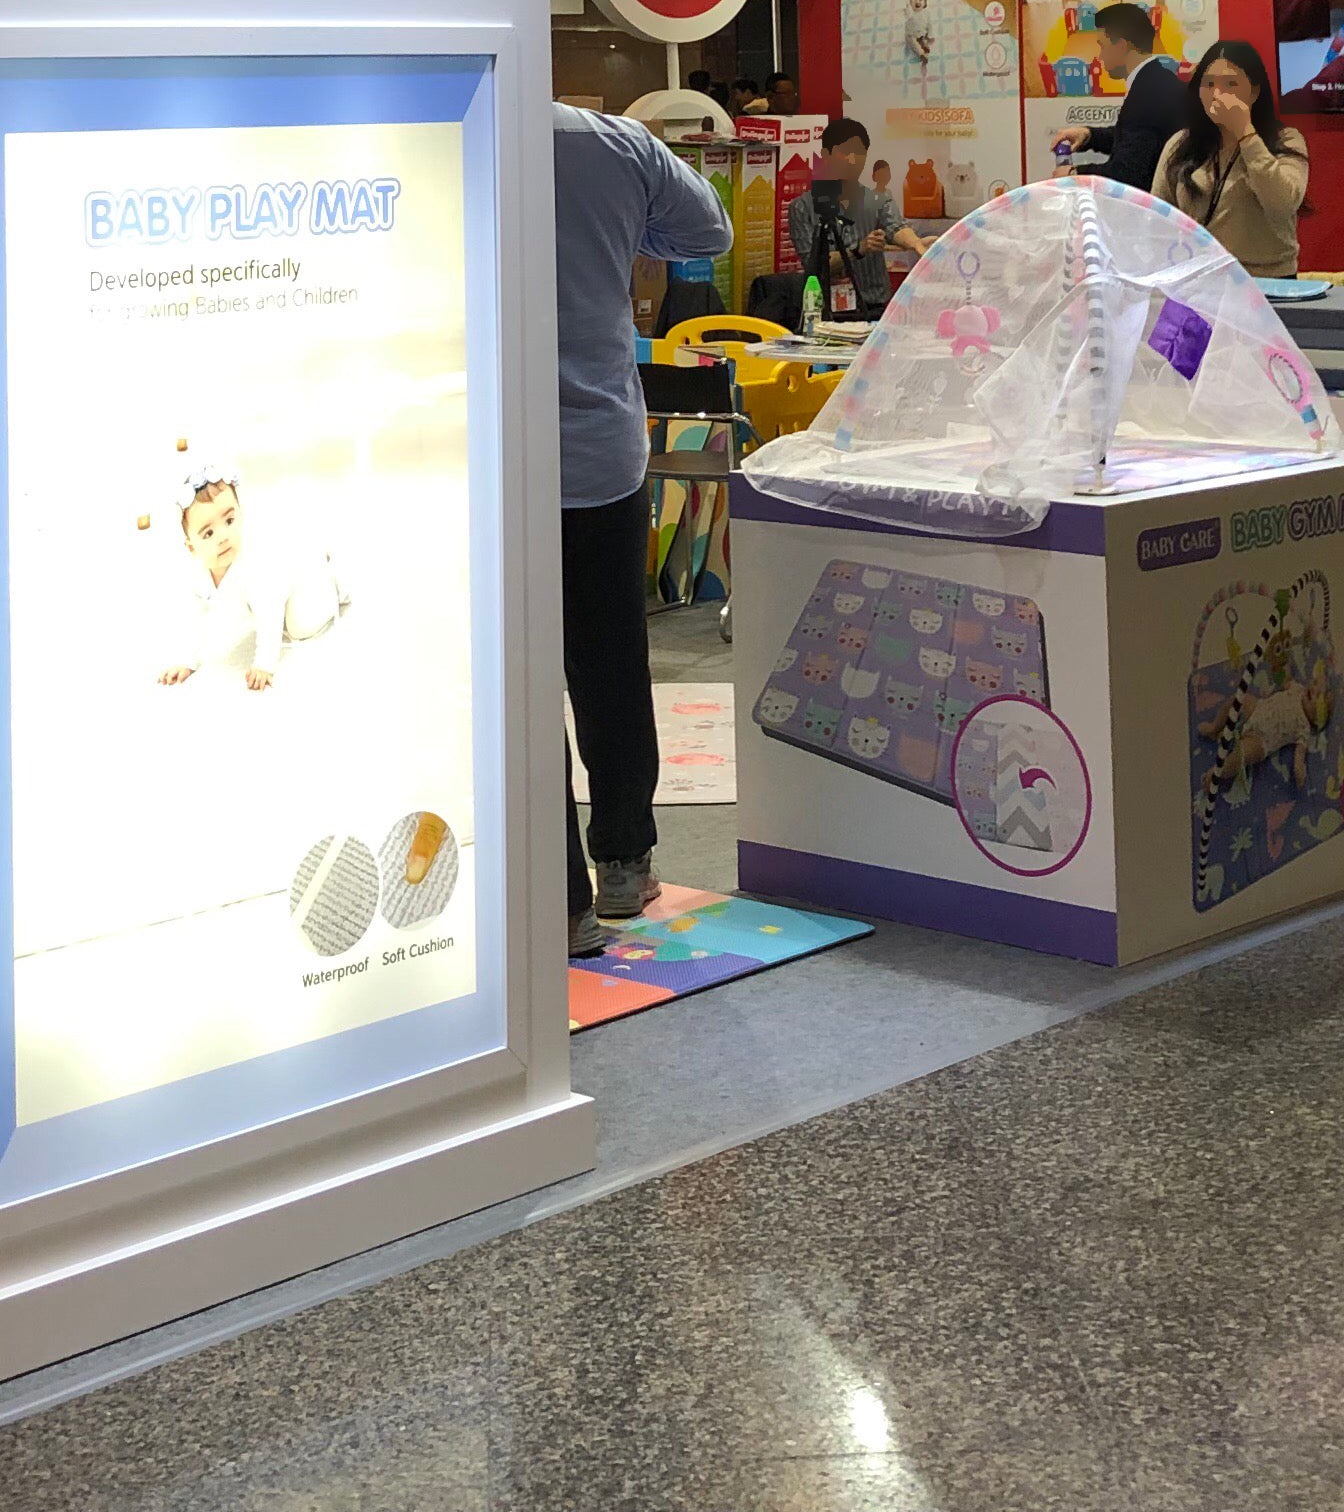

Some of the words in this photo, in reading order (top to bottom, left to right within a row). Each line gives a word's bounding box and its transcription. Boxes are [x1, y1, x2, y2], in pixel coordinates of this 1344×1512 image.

[944, 108, 974, 123] SOFA
[1067, 107, 1114, 123] ACCENT
[89, 191, 198, 243] BABY
[209, 187, 305, 235] PLAY
[313, 182, 398, 231] MAT
[90, 264, 193, 292] Developed
[201, 257, 301, 288] specifically
[196, 293, 250, 315] Babies
[256, 288, 287, 310] and
[292, 287, 358, 306] Children
[1232, 505, 1286, 552] BABY
[1288, 496, 1336, 540] GYM
[1141, 537, 1176, 561] BABY
[1180, 527, 1216, 553] CARE
[382, 948, 406, 966] Soft
[409, 937, 454, 958] Cushion
[302, 957, 369, 988] Waterproof
